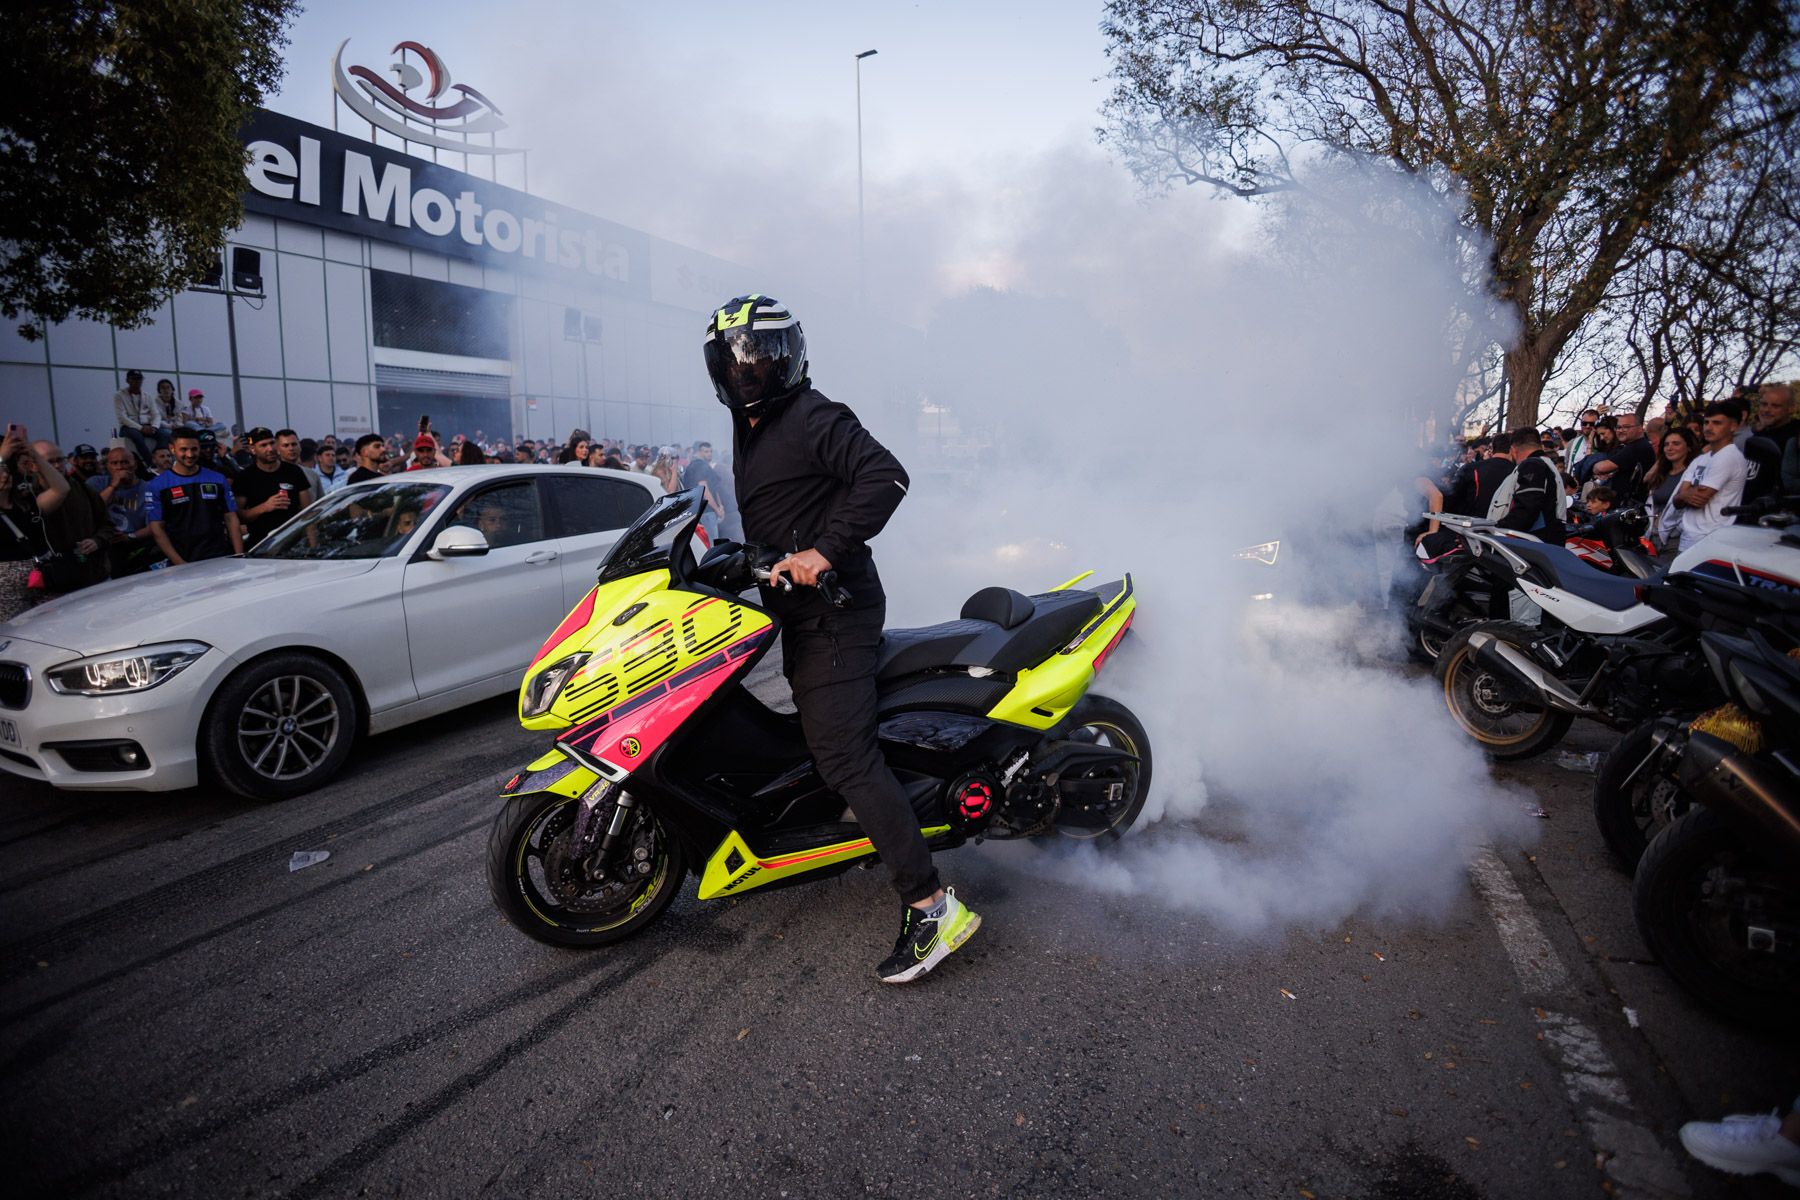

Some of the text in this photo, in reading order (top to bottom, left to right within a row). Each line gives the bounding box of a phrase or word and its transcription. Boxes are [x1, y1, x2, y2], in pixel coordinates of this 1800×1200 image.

[245, 135, 630, 282] el Motorista
[724, 866, 763, 892] MOTUL
